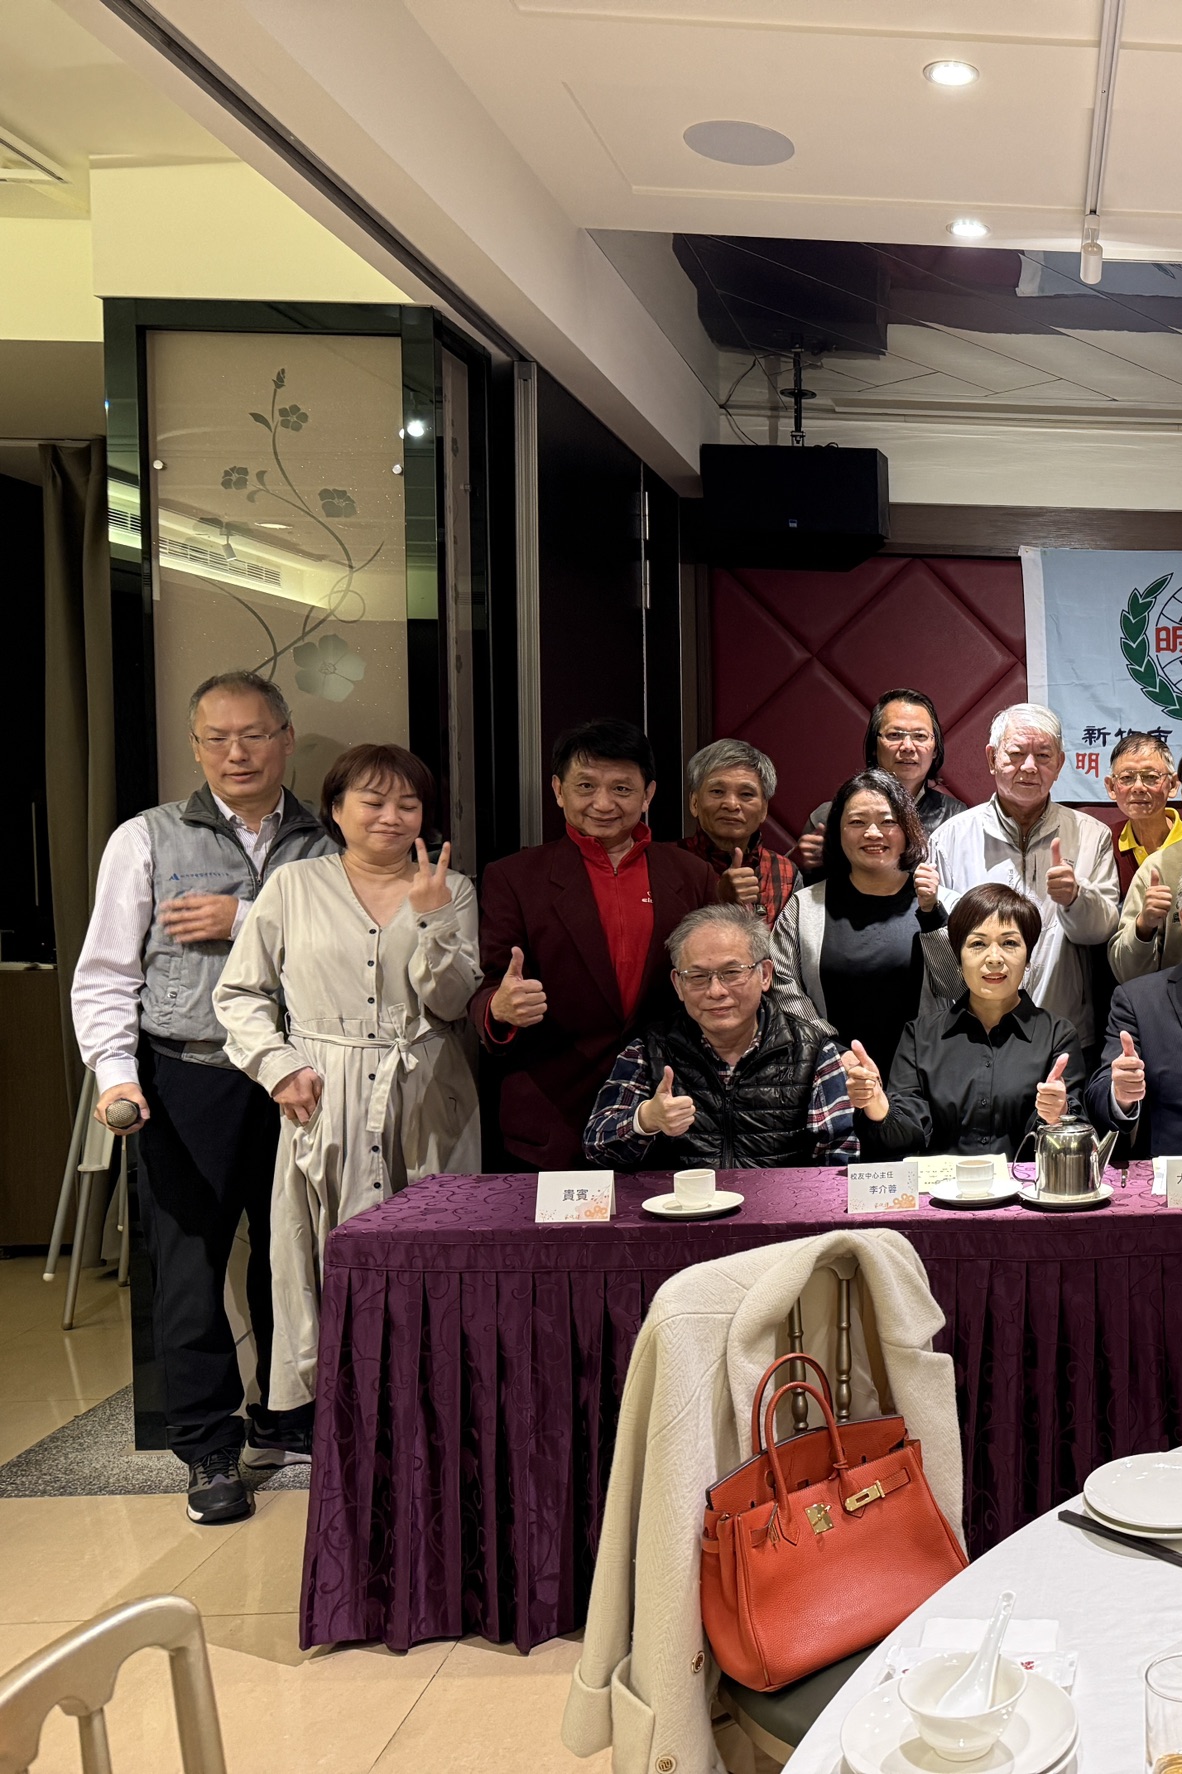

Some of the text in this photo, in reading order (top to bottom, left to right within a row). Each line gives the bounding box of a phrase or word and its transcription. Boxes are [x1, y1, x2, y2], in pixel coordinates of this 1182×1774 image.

[850, 1171, 894, 1180] 校友中心主任
[562, 1188, 589, 1202] 貴賓
